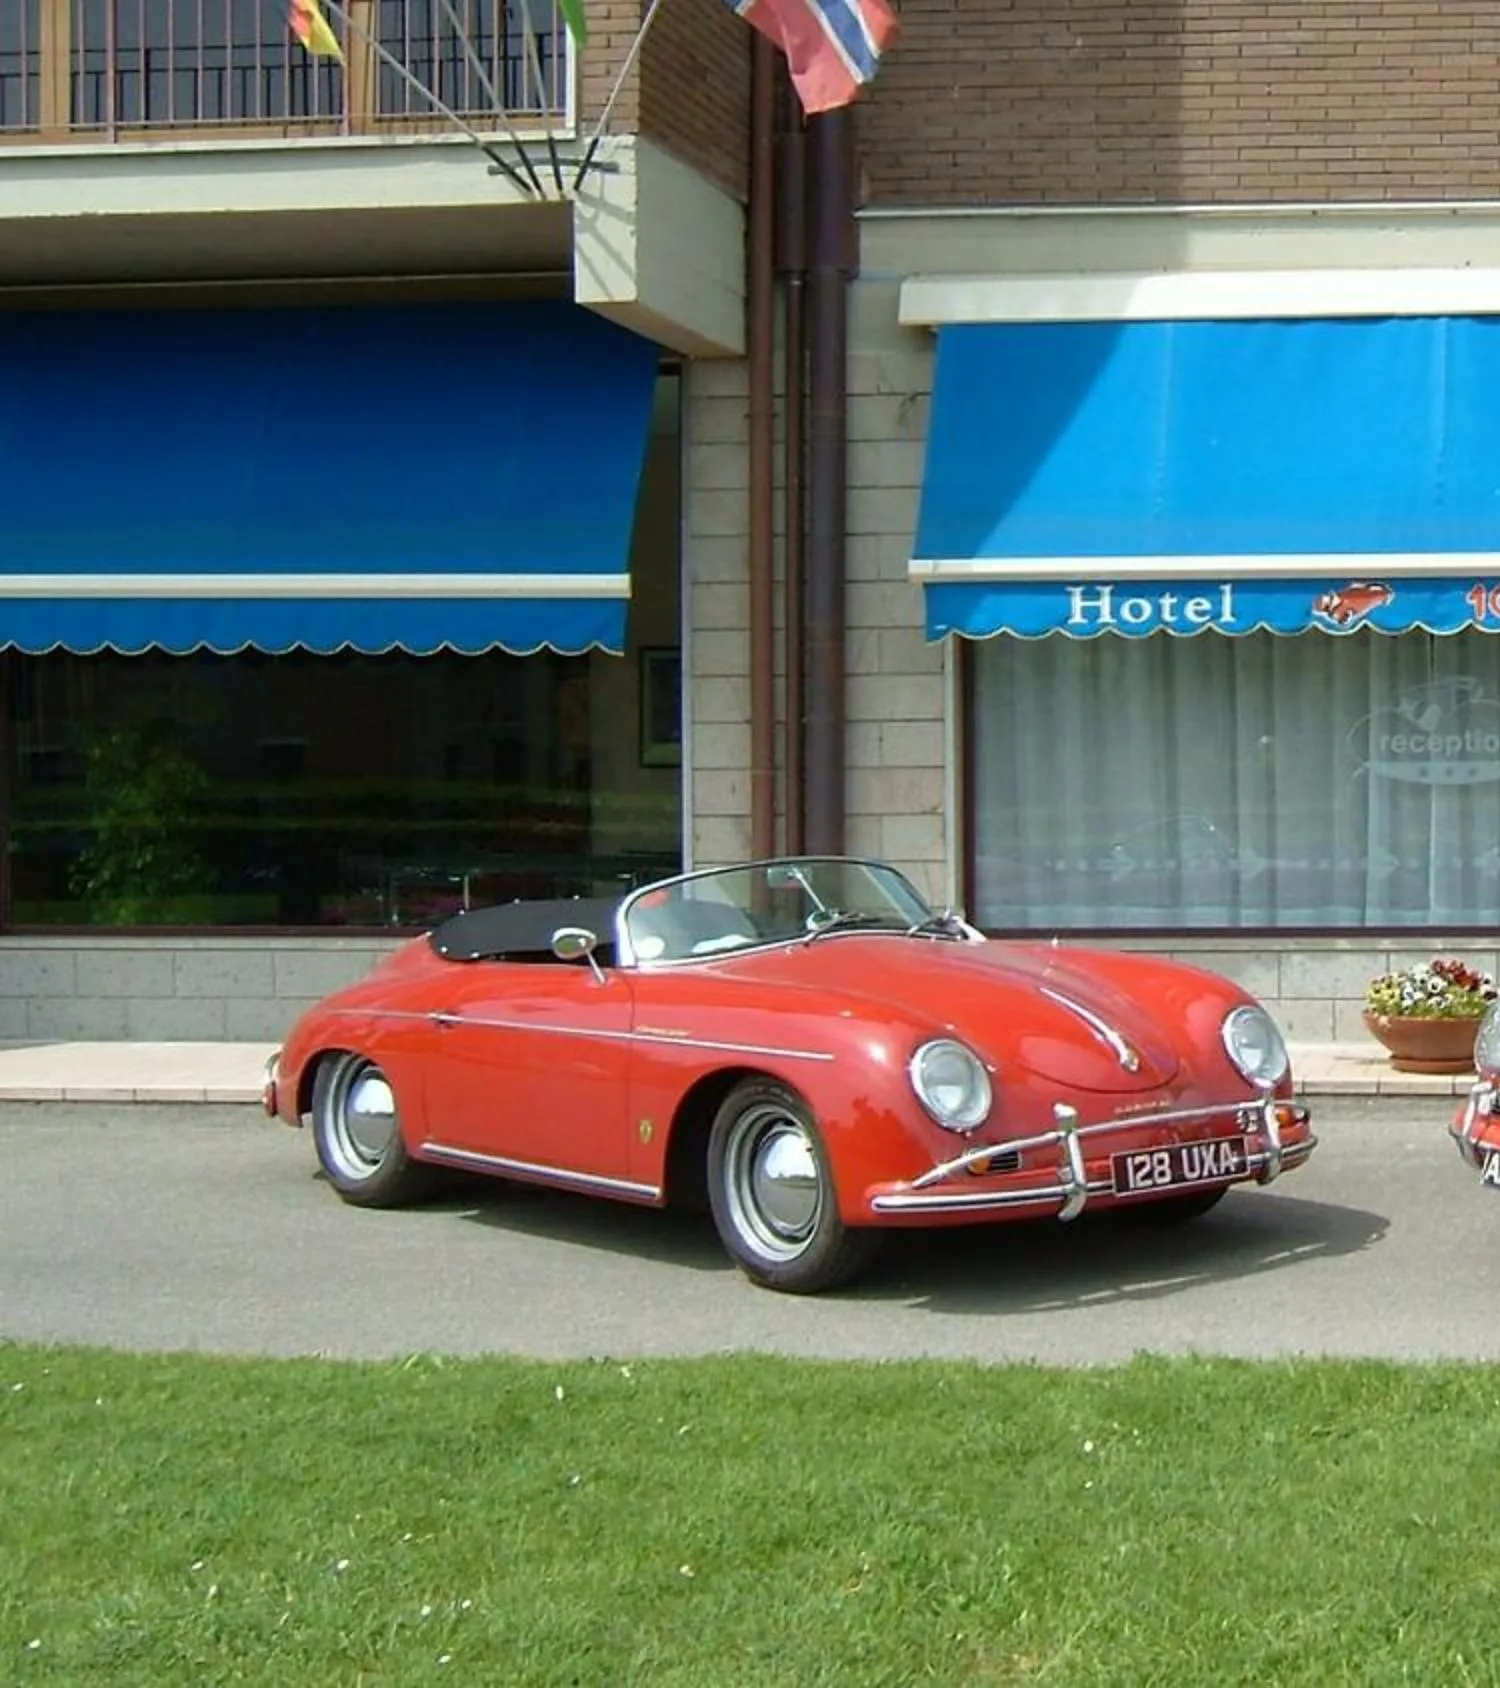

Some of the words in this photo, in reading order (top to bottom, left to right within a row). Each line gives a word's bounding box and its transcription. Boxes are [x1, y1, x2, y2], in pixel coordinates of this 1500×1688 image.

[1065, 584, 1237, 624] Hotel
[1127, 1153, 1171, 1189] 128
[1182, 1140, 1235, 1183] UXA
